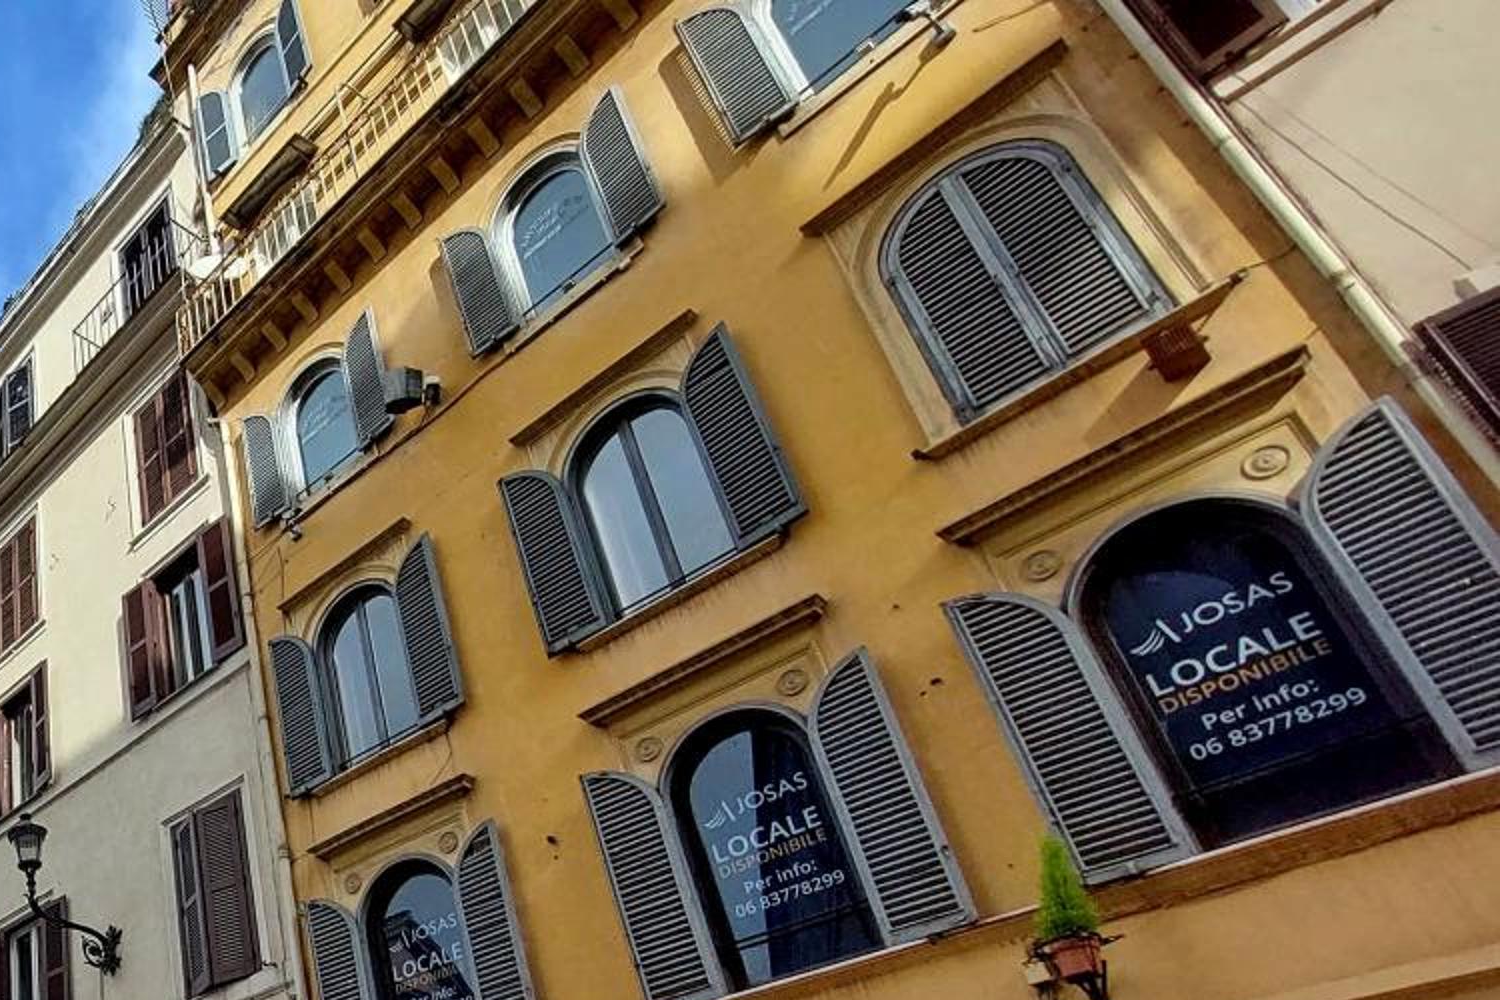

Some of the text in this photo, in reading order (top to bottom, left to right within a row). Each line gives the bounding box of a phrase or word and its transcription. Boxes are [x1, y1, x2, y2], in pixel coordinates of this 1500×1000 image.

[1181, 571, 1294, 635] JOSAS
[1145, 611, 1323, 698] LOCALE
[1156, 638, 1333, 715] DISPONIBILE
[1190, 686, 1368, 761] 06 83778299
[1202, 704, 1247, 731] Per
[735, 771, 809, 815] JOSAS
[711, 805, 822, 864] LOCALE
[718, 828, 828, 880] DISPONIBILE
[735, 868, 846, 919] 06 83778299
[743, 875, 774, 894] Per
[393, 941, 464, 982] LOCALE
